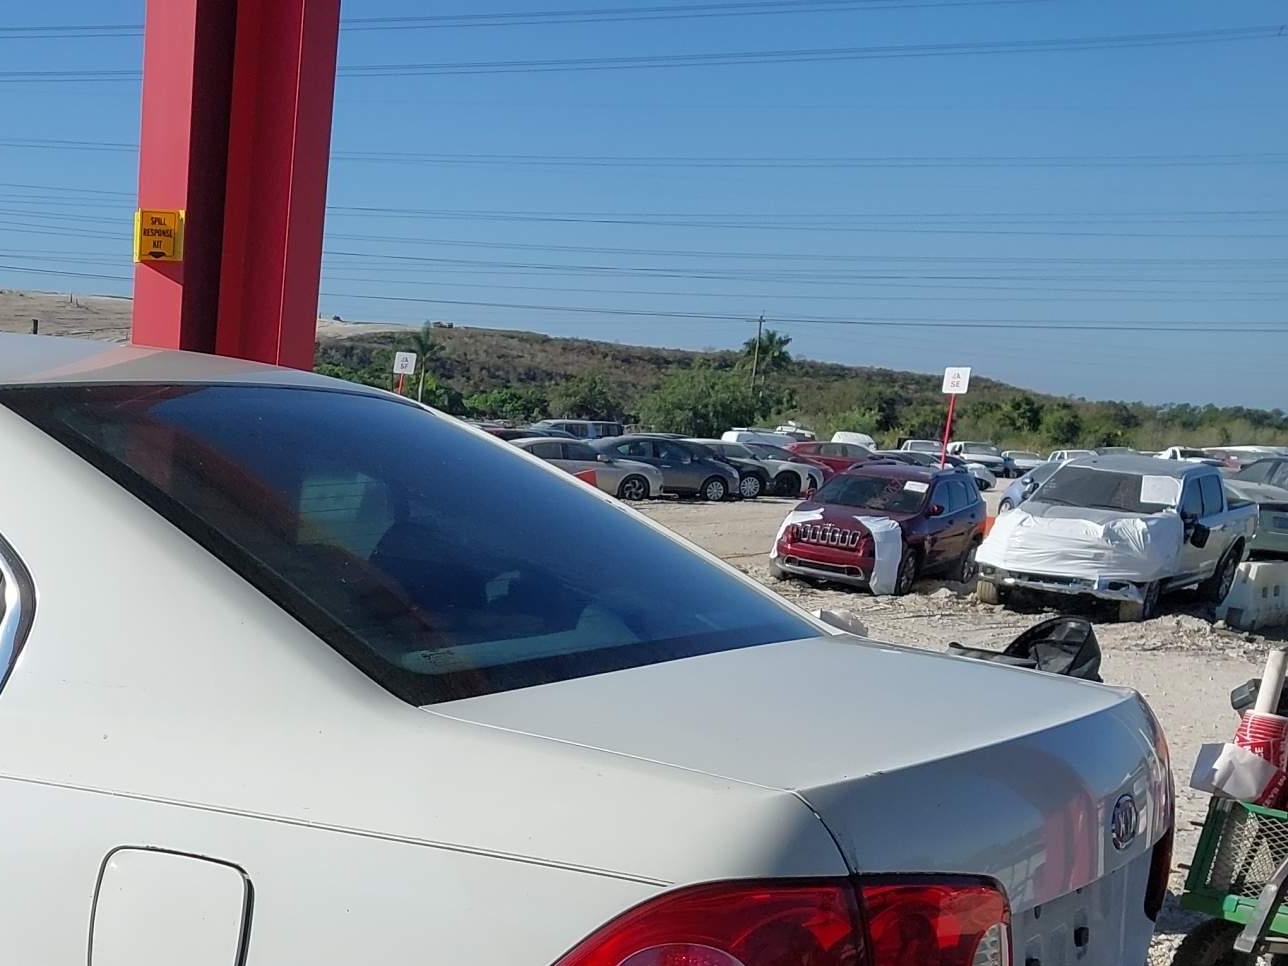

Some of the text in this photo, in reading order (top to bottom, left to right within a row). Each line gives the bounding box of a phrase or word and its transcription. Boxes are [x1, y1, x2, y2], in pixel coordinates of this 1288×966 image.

[150, 216, 167, 226] SPILL
[143, 228, 173, 238] RESPONSE
[152, 240, 162, 249] KIT
